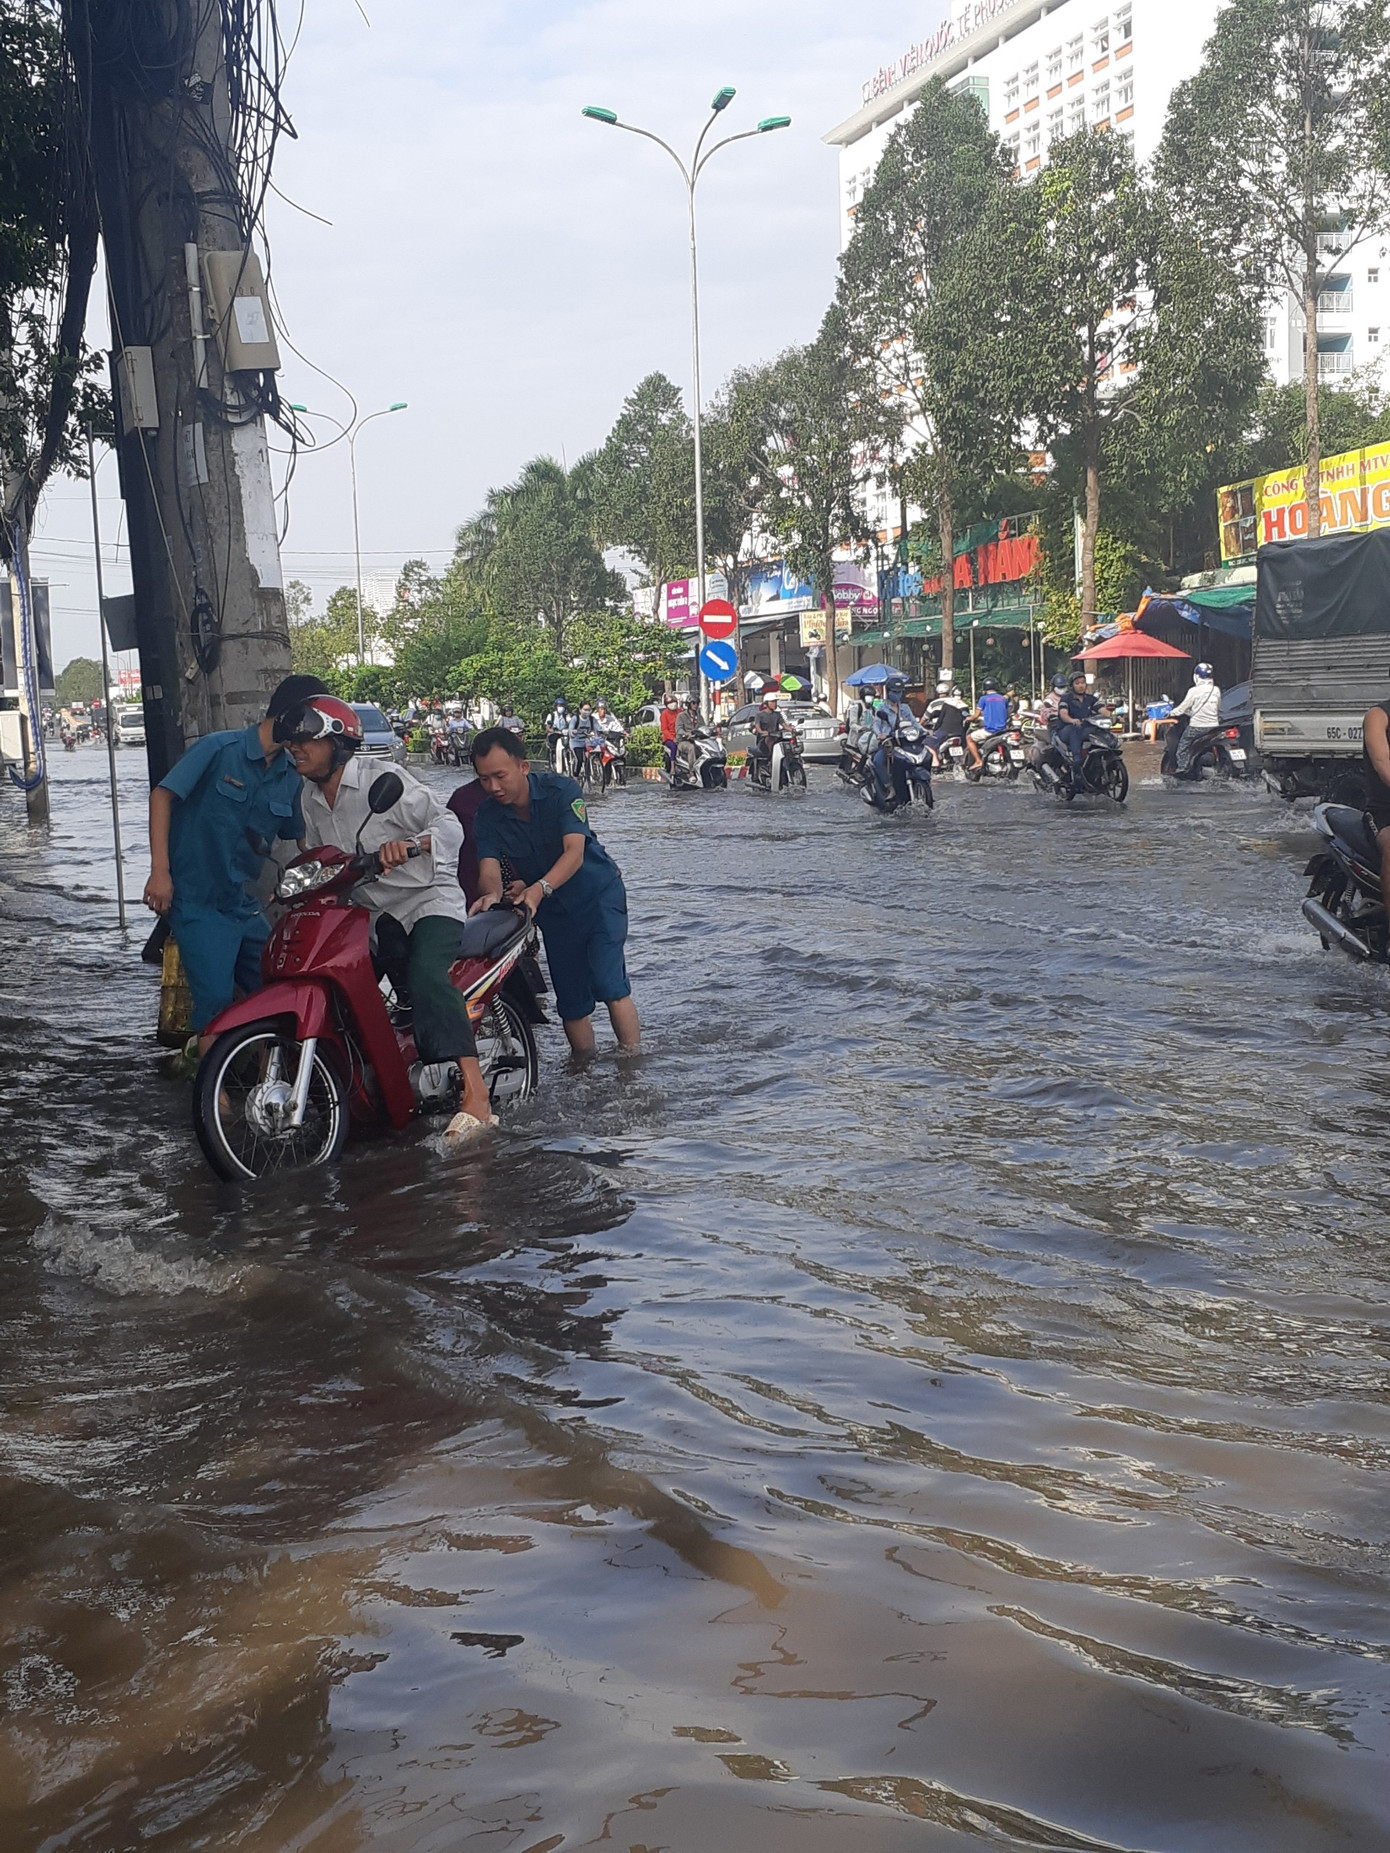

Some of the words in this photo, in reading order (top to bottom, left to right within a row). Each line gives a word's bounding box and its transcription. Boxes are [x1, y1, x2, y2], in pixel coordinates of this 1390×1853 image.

[1264, 478, 1299, 497] CÔNG
[1320, 463, 1355, 483] TNHH
[1359, 453, 1389, 473] MTV
[290, 911, 321, 919] HONDA
